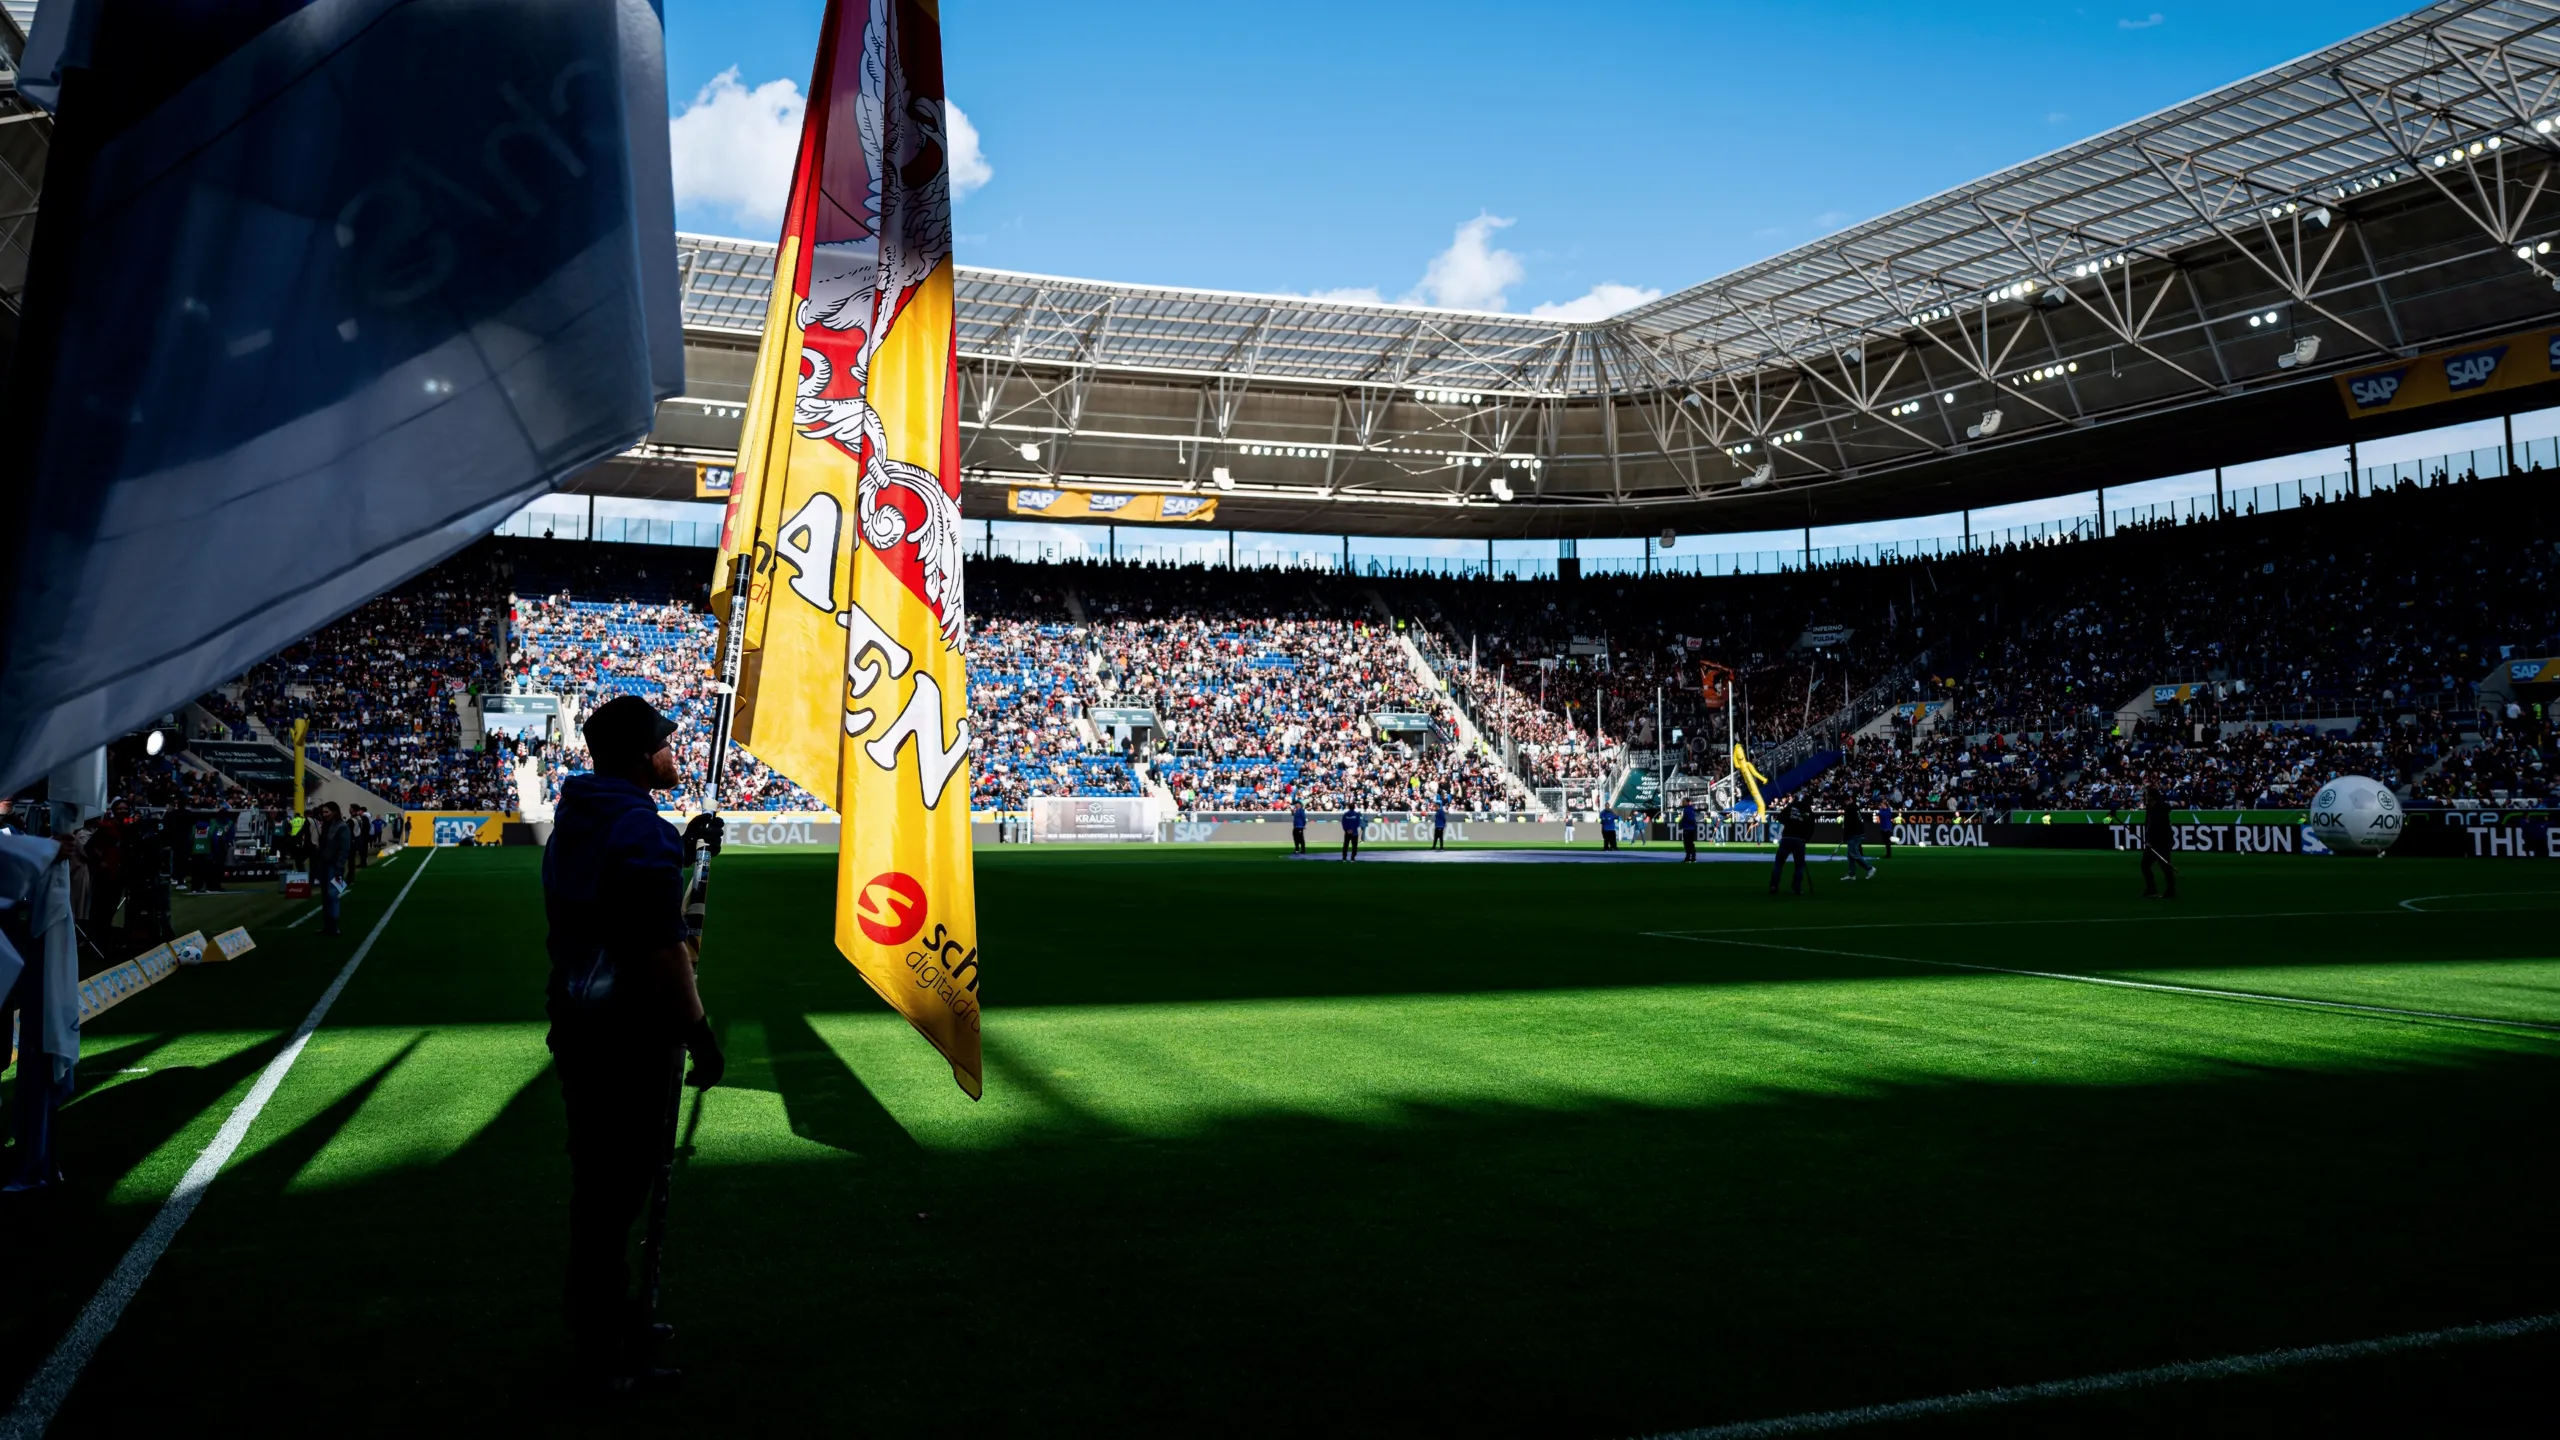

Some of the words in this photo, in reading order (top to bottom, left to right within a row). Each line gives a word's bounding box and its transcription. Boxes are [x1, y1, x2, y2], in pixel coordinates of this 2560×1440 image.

[2351, 377, 2398, 403] SAP
[2446, 356, 2496, 385] SAP
[706, 467, 733, 487] SA
[1018, 490, 1054, 507] SAP
[1090, 495, 1127, 511] SAP
[1163, 499, 1199, 514] SAP
[2511, 664, 2541, 679] SAP
[2155, 688, 2176, 701] SAP
[1075, 814, 1116, 823] KRAUSS
[2313, 812, 2345, 827] AOK
[2369, 814, 2401, 829] AOK
[747, 823, 818, 844] GOAL
[1174, 823, 1213, 842] SAP
[1365, 822, 1409, 841] ONE
[1667, 823, 1684, 841] TH
[1697, 823, 1731, 841] BET
[1735, 823, 1764, 842] RUN
[1893, 823, 1931, 845] ONE
[1936, 823, 1989, 846] GOAL
[2109, 825, 2146, 850] TH
[2171, 825, 2225, 851] BEST
[2235, 825, 2293, 853] RUN
[922, 923, 979, 993] sch
